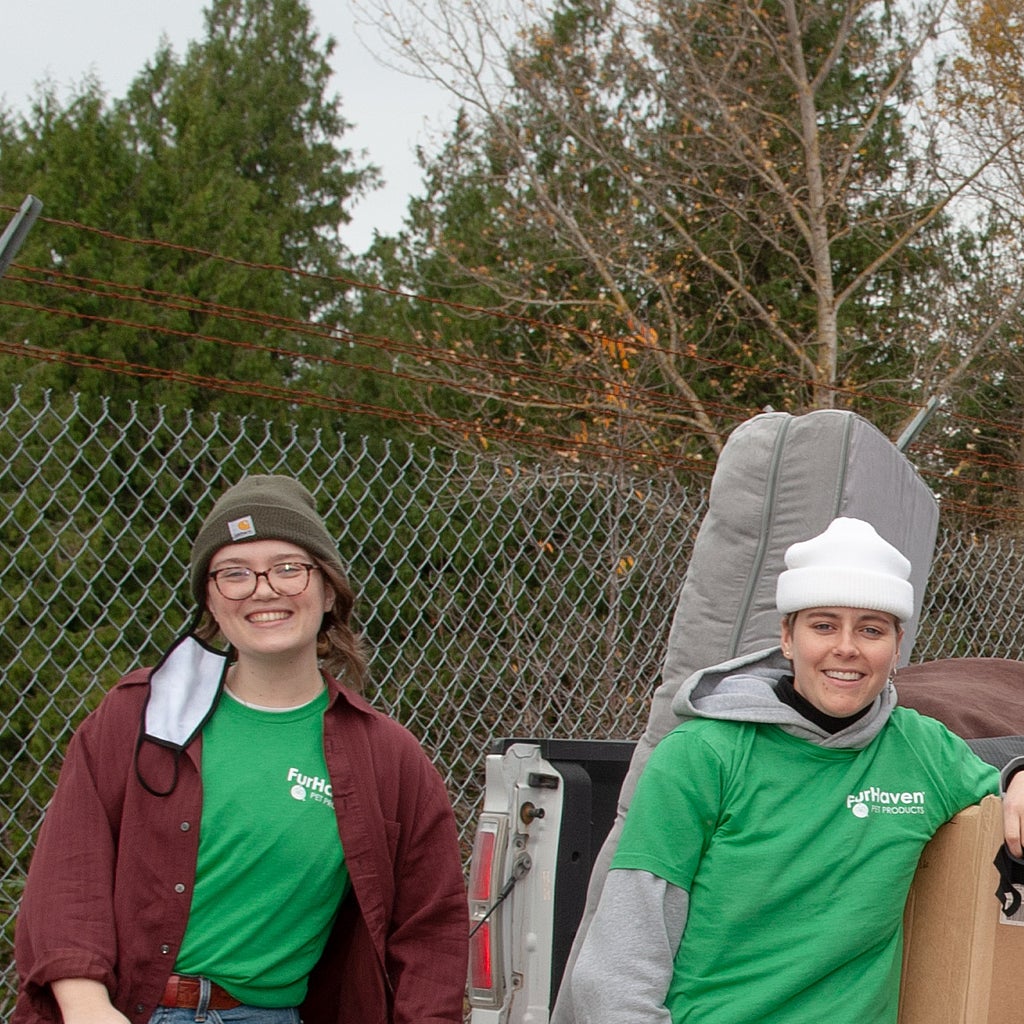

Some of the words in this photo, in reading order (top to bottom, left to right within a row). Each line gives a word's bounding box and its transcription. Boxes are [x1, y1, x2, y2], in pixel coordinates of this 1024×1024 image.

[287, 767, 333, 797] FurHa
[846, 786, 925, 809] FurHaven
[882, 806, 925, 815] PRODUCTS
